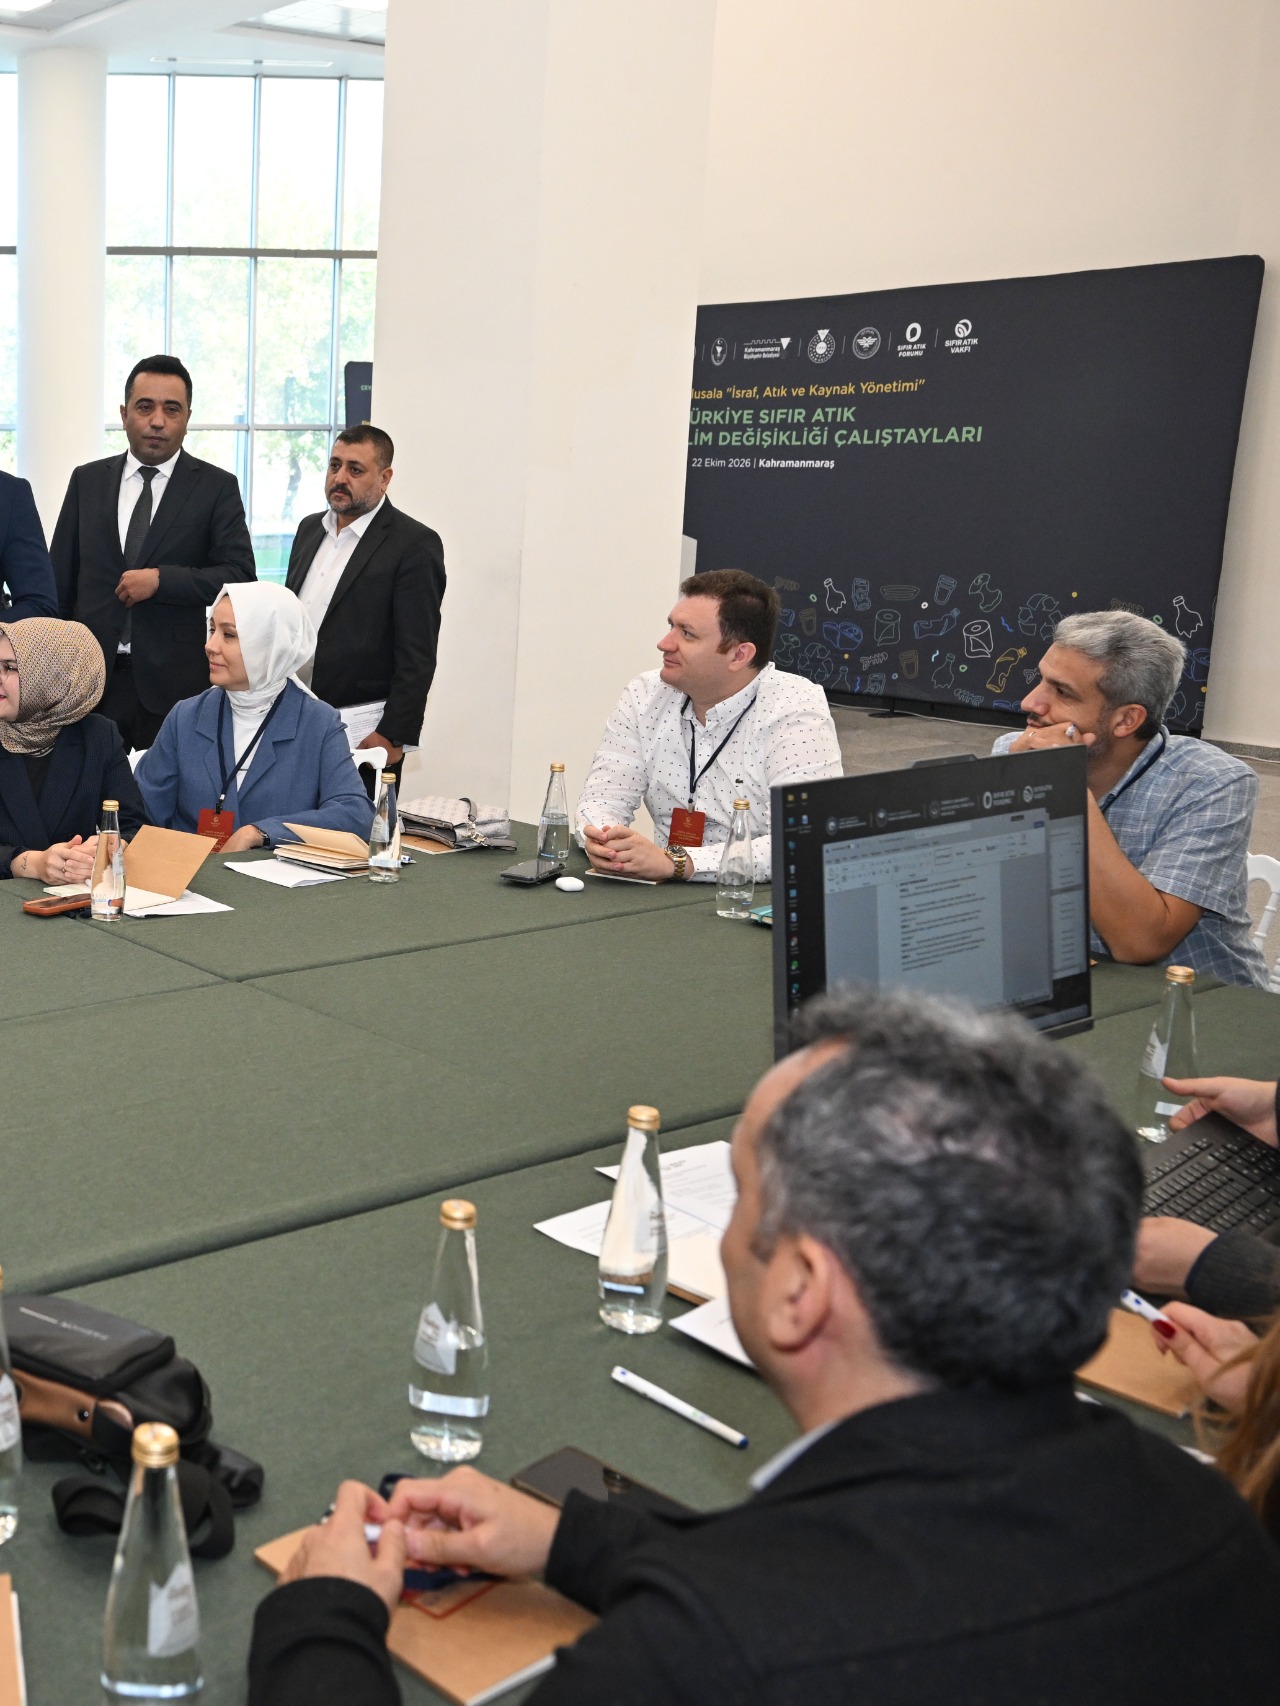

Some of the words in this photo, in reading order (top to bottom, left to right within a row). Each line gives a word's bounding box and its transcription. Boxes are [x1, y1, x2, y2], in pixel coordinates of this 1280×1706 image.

[944, 339, 962, 347] SIFIR
[962, 337, 979, 346] ATIK
[898, 350, 924, 358] FORUMU
[950, 346, 971, 354] VAKFI
[691, 387, 723, 399] lusala
[763, 385, 787, 398] Atık
[791, 387, 805, 397] ve
[809, 382, 855, 398] Kaynak
[690, 407, 754, 425] ÜRKİYE
[759, 408, 806, 424] SIFIR
[811, 407, 857, 423] ATIK
[718, 426, 828, 448] DEĞİŞİKLİĞİ
[834, 426, 983, 448] ÇALIŞTAYLARI
[691, 458, 702, 467] 22
[704, 457, 726, 467] Ekim
[759, 457, 835, 469] Kahramanmaraş
